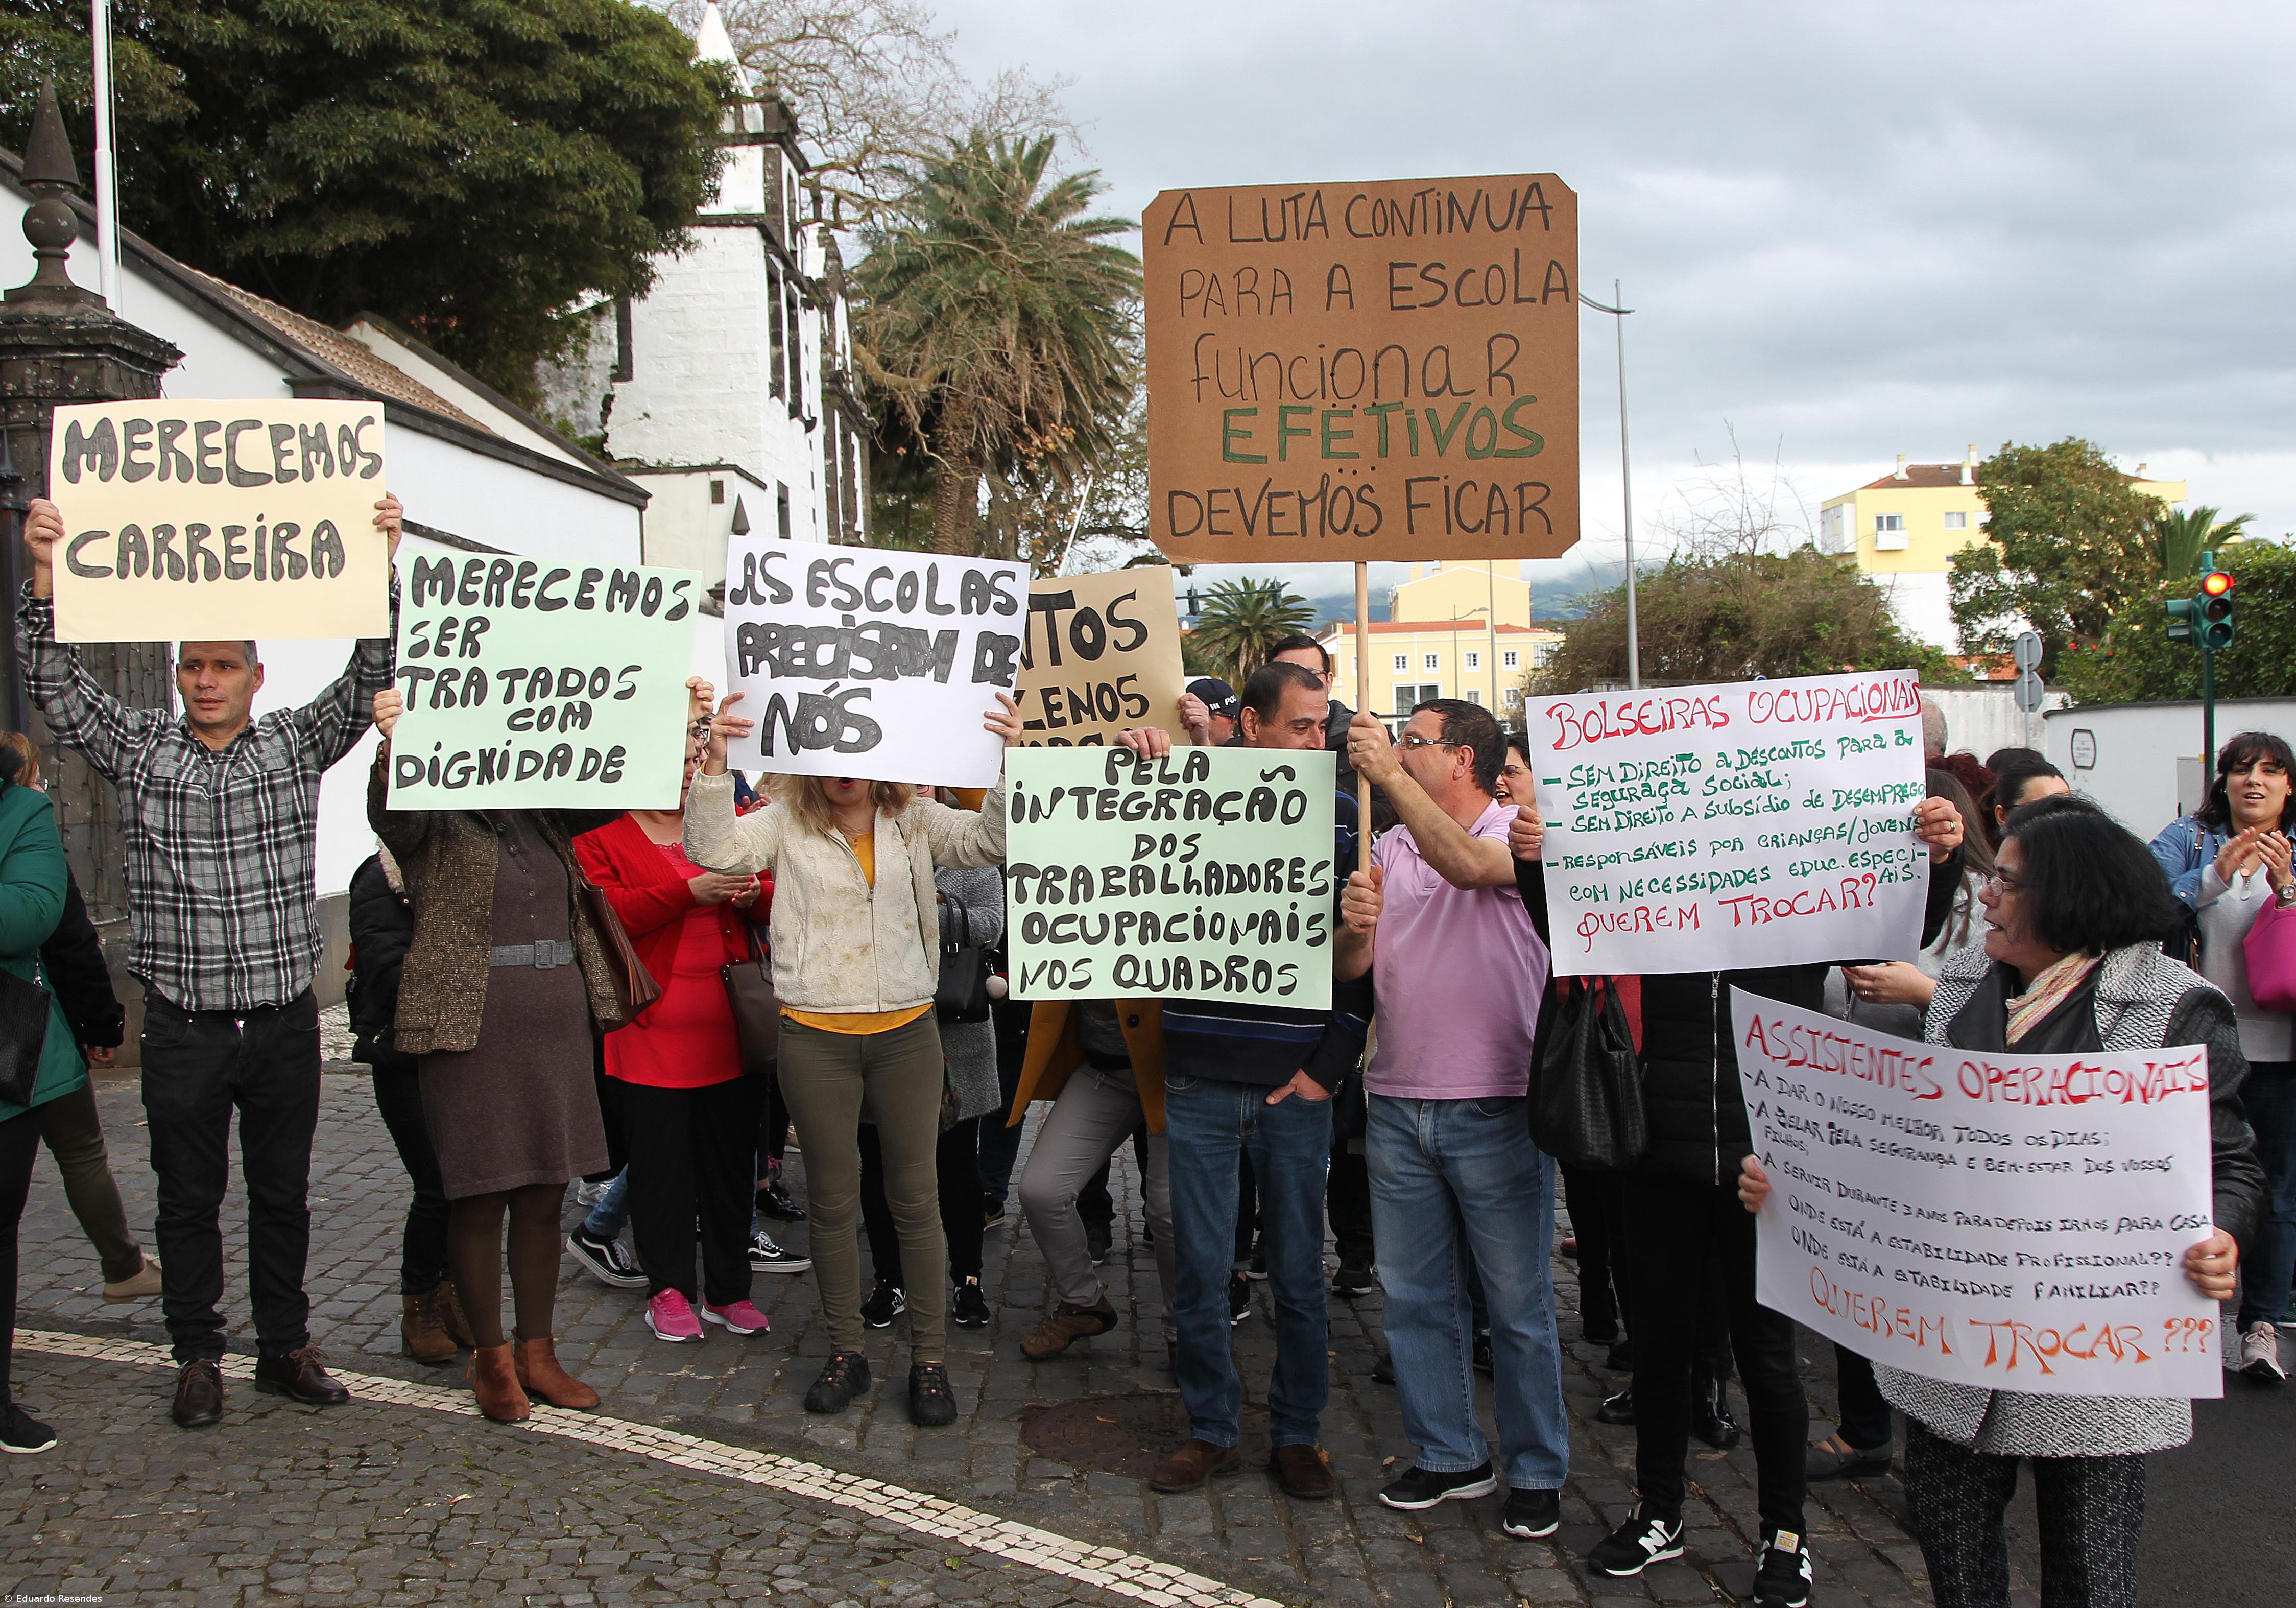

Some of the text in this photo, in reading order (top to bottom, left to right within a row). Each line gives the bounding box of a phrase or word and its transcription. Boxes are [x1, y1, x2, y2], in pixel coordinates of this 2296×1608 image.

[1164, 182, 1553, 245] A LUTA CONTINUA
[1180, 248, 1570, 318] PARA A ESCOLA
[62, 415, 382, 487] MERECEMOS
[1223, 395, 1545, 463] EFETIVOS
[1168, 472, 1553, 538] DEVEMOS FICAR
[66, 513, 345, 583] CARREIRA
[412, 556, 691, 621] MERECEMOS
[730, 551, 1018, 616] AS ESCOLAS
[408, 616, 490, 658] SER
[971, 630, 1020, 687] DE
[507, 701, 592, 733] COM
[761, 681, 882, 758] NÓS
[1545, 678, 1922, 750] BOLSEIRAS OCUPACIONAIS
[1105, 749, 1211, 785] PELA
[1735, 739, 1826, 772] DESCONTOS
[1011, 765, 1307, 825] INTEGRAÇÃO
[1680, 806, 1698, 822] A
[1131, 833, 1201, 863] DOS
[1576, 872, 1876, 953] QUEREM TROCAR?
[1619, 865, 1771, 903] NECESSIDADES
[1020, 954, 1299, 996] NOS QUADROS
[1745, 1014, 2208, 1106] ASSISTENTES OPERACIONAIS
[1776, 1075, 1810, 1103] DAR
[1814, 1092, 1825, 1107] O
[1829, 1096, 1875, 1120] NOSSO
[1953, 1126, 2013, 1146] TODOS
[1966, 1157, 1976, 1170] E
[2084, 1158, 2114, 1175] DOS
[2121, 1154, 2175, 1174] VOSSOS
[1788, 1193, 1825, 1224] ONDE
[1830, 1220, 1865, 1239] ESTÁ
[1870, 1231, 1883, 1246] A
[1888, 1236, 2008, 1267] ESTABILIDADE
[1837, 1181, 1898, 1213] DURANTE
[1902, 1204, 1912, 1216] 3
[1915, 1207, 1948, 1223] ANOS
[2114, 1217, 2163, 1235] PARA
[1791, 1226, 1829, 1260] ONDE
[1838, 1252, 1869, 1274] ESTÁ
[1873, 1264, 1884, 1278] A
[1894, 1269, 2014, 1299] ESTABILIDADE
[1809, 1266, 1953, 1355] QUEREM
[1969, 1318, 2152, 1376] TROCAR
